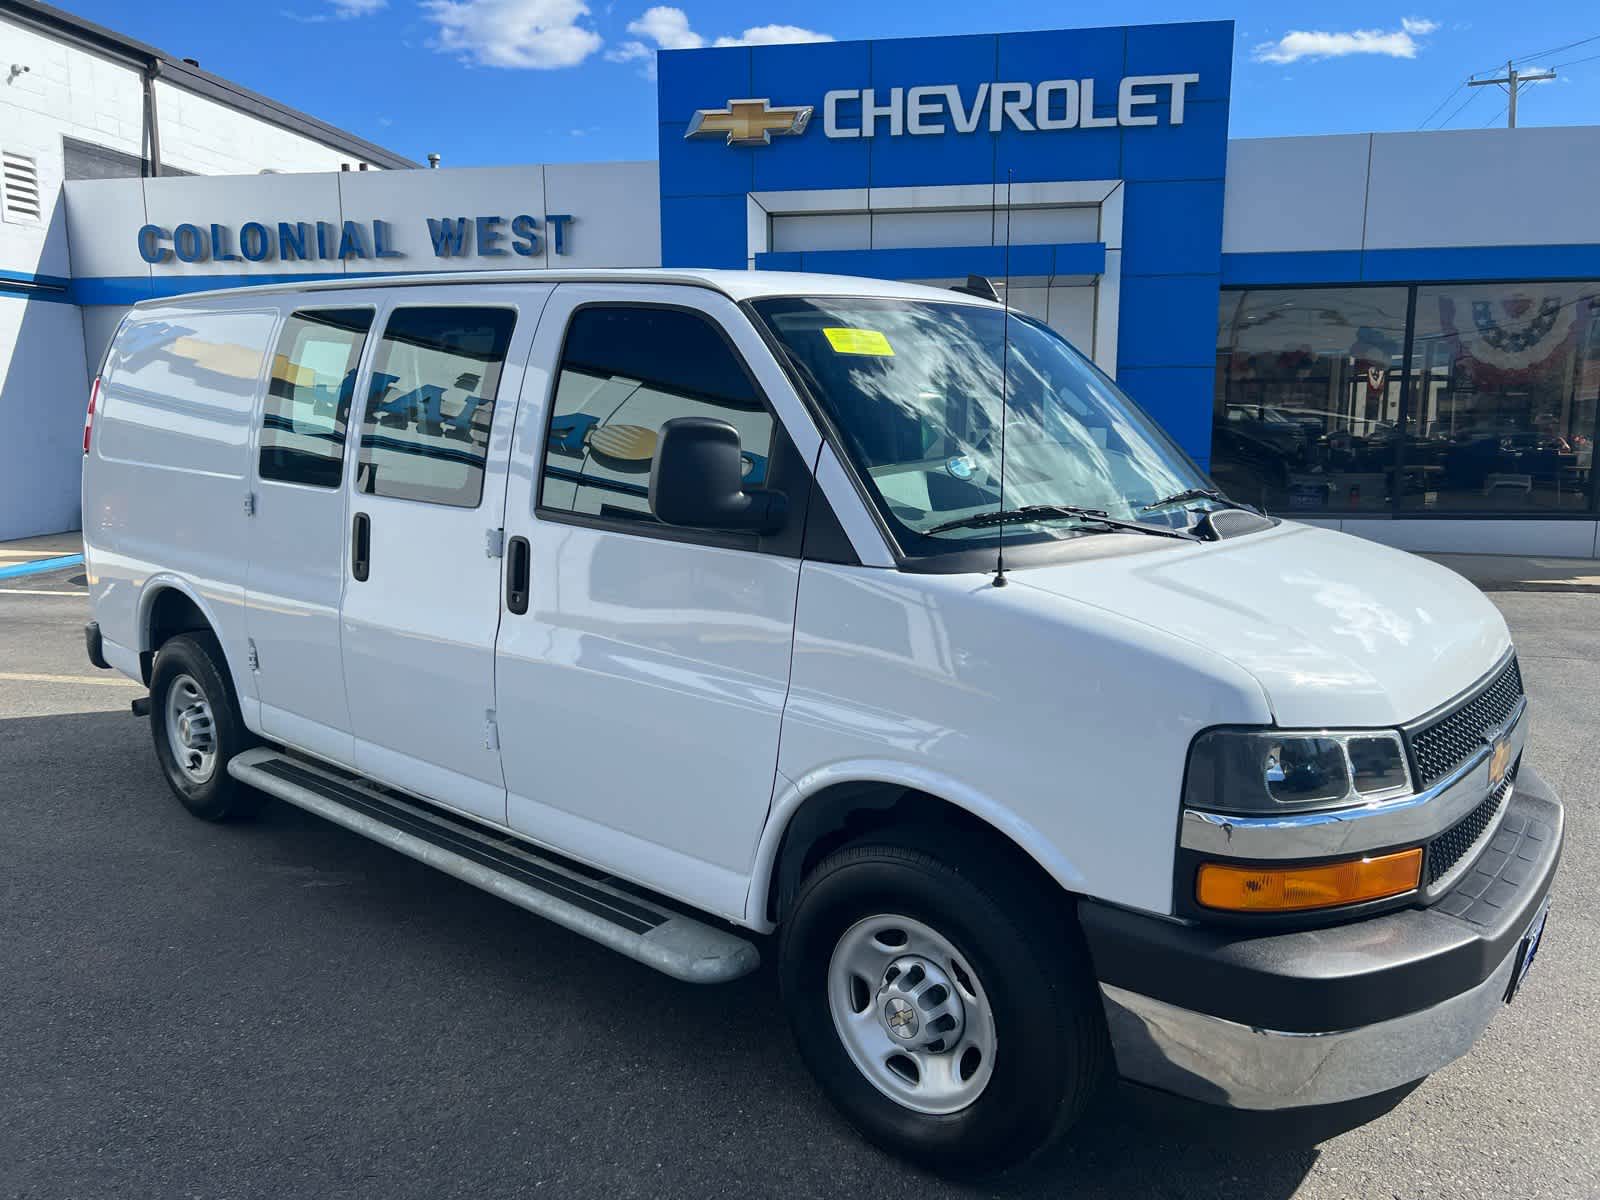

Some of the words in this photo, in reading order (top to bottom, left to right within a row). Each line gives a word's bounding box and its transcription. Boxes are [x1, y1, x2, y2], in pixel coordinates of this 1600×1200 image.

[823, 73, 1200, 139] CHEVROLET
[137, 219, 403, 263] COLONIAL
[427, 213, 576, 258] WEST
